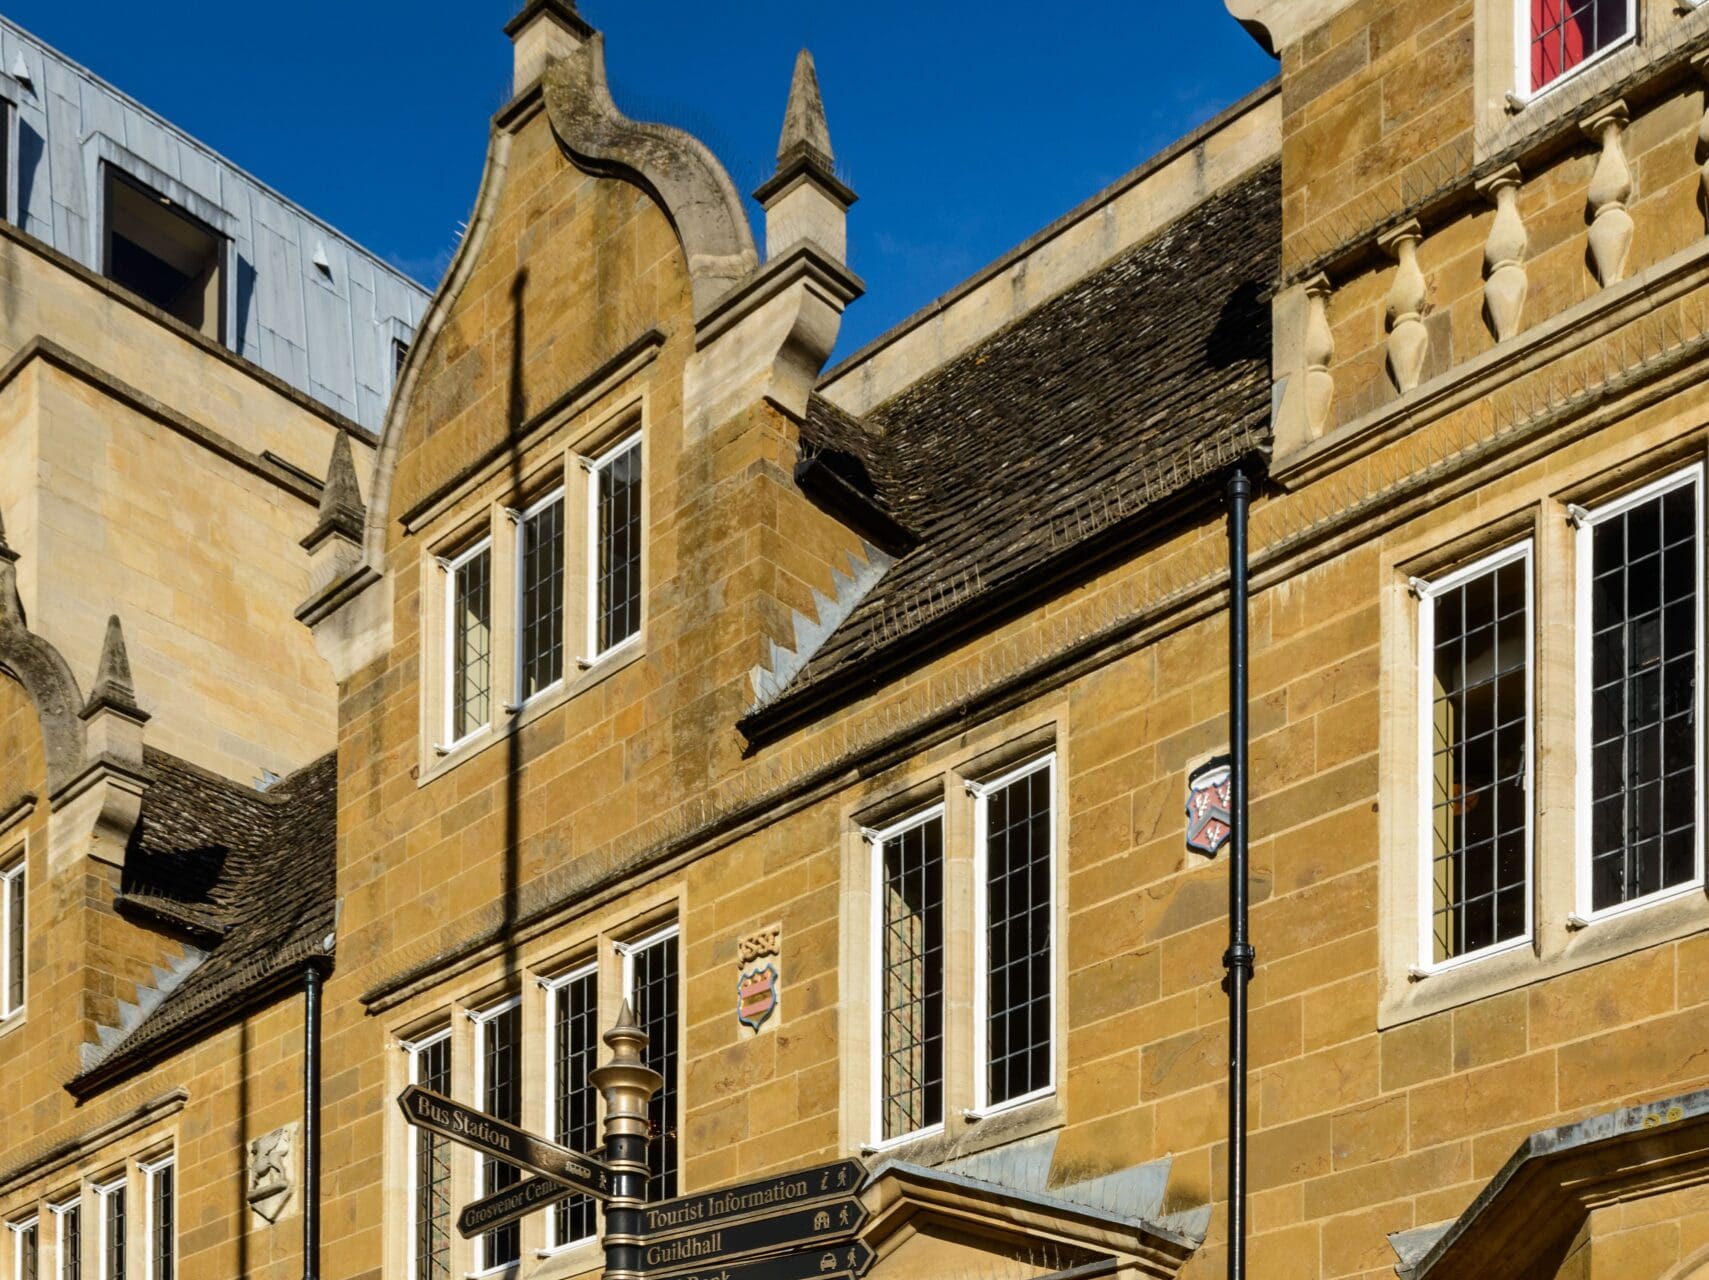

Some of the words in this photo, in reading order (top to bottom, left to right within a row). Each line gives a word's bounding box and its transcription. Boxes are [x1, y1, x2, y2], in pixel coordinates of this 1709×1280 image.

[418, 1094, 450, 1124] Bus
[452, 1110, 511, 1150] Station
[465, 1190, 525, 1227] Grosvenor
[646, 1203, 704, 1229] Tourist
[708, 1180, 808, 1217] Information
[646, 1232, 722, 1266] Guildhall
